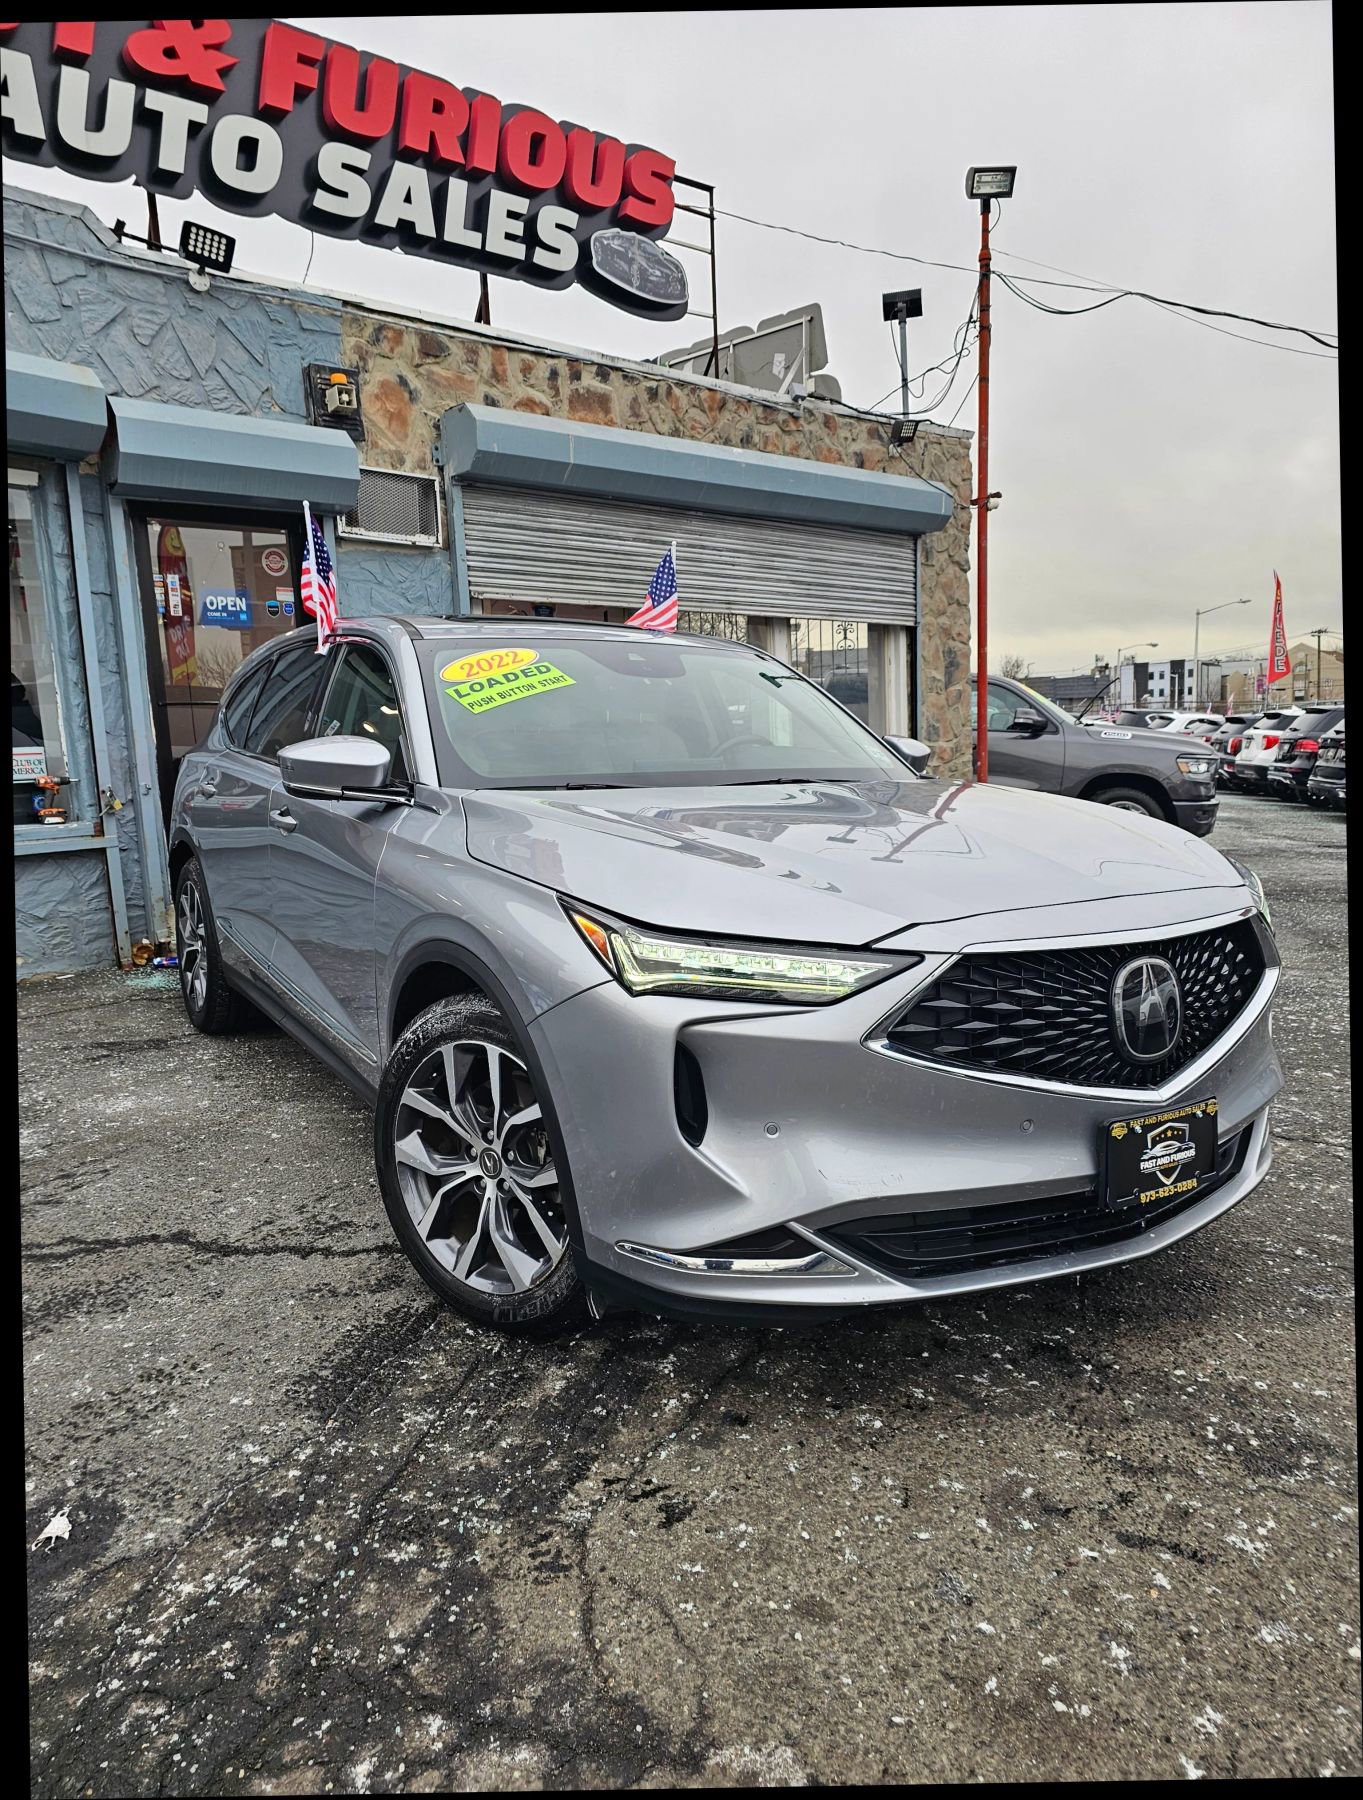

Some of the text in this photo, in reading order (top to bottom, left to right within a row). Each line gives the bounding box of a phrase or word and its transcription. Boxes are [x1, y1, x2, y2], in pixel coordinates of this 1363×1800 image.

[258, 21, 676, 231] FURIOUS
[0, 47, 580, 273] AUTO SALES
[206, 595, 247, 612] OPEN
[459, 650, 524, 680] 2022
[453, 663, 553, 699] LOADED
[467, 674, 568, 711] PUSH BUTTON START
[13, 767, 45, 775] MERICA
[33, 758, 44, 766] OF
[1130, 1118, 1144, 1128] FAST
[1144, 1116, 1157, 1125] AND
[1157, 1111, 1179, 1122] FURIOUS
[1179, 1107, 1192, 1117] AUTO
[1140, 1148, 1196, 1170] FAST AND FURIOUS
[1140, 1178, 1197, 1204] 973-623-0284
